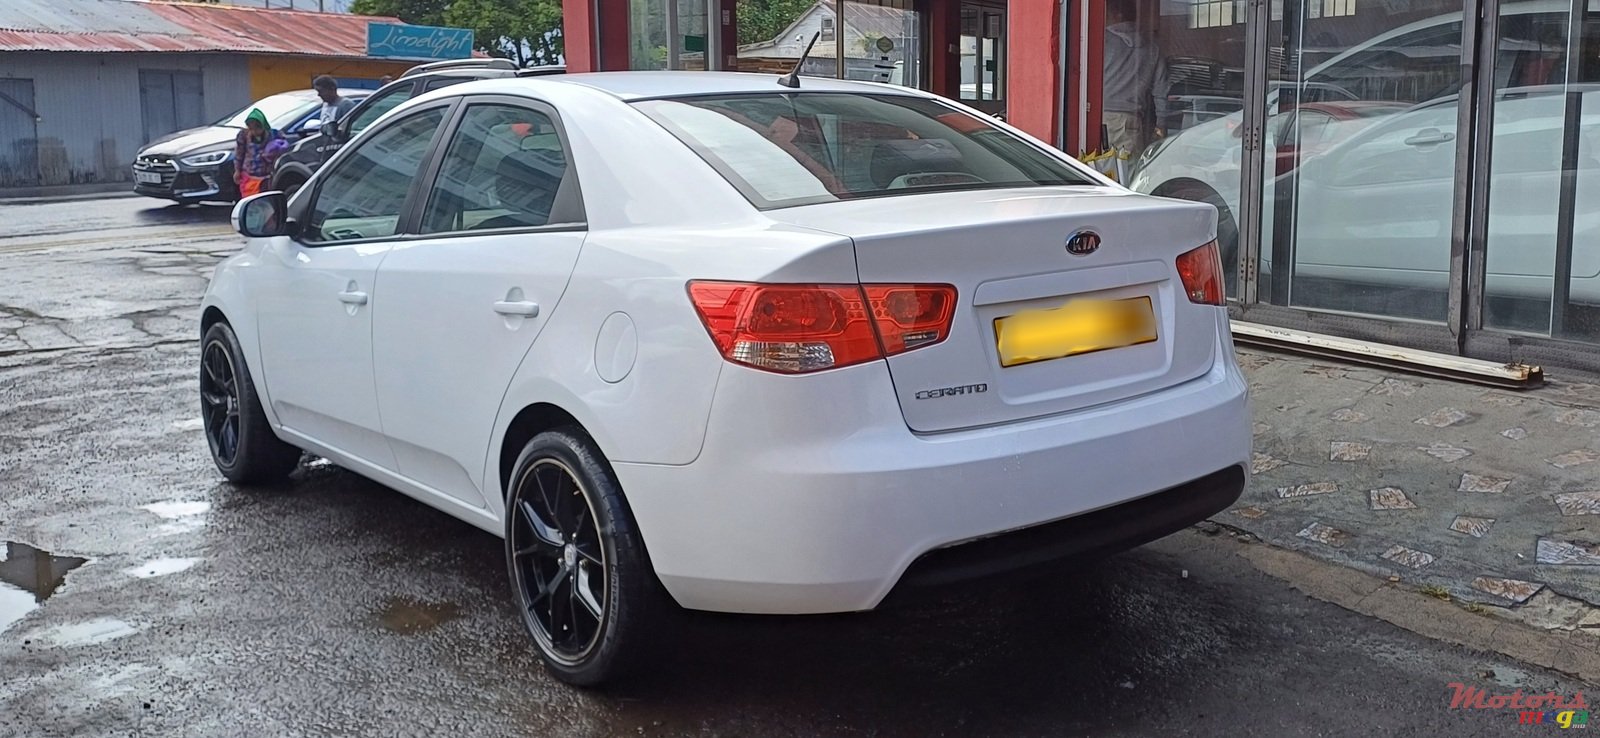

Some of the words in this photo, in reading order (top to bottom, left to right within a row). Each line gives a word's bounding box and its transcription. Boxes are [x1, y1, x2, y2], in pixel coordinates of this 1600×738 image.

[370, 26, 472, 57] Limelight
[1071, 235, 1097, 251] KIA
[915, 383, 988, 400] CERATO
